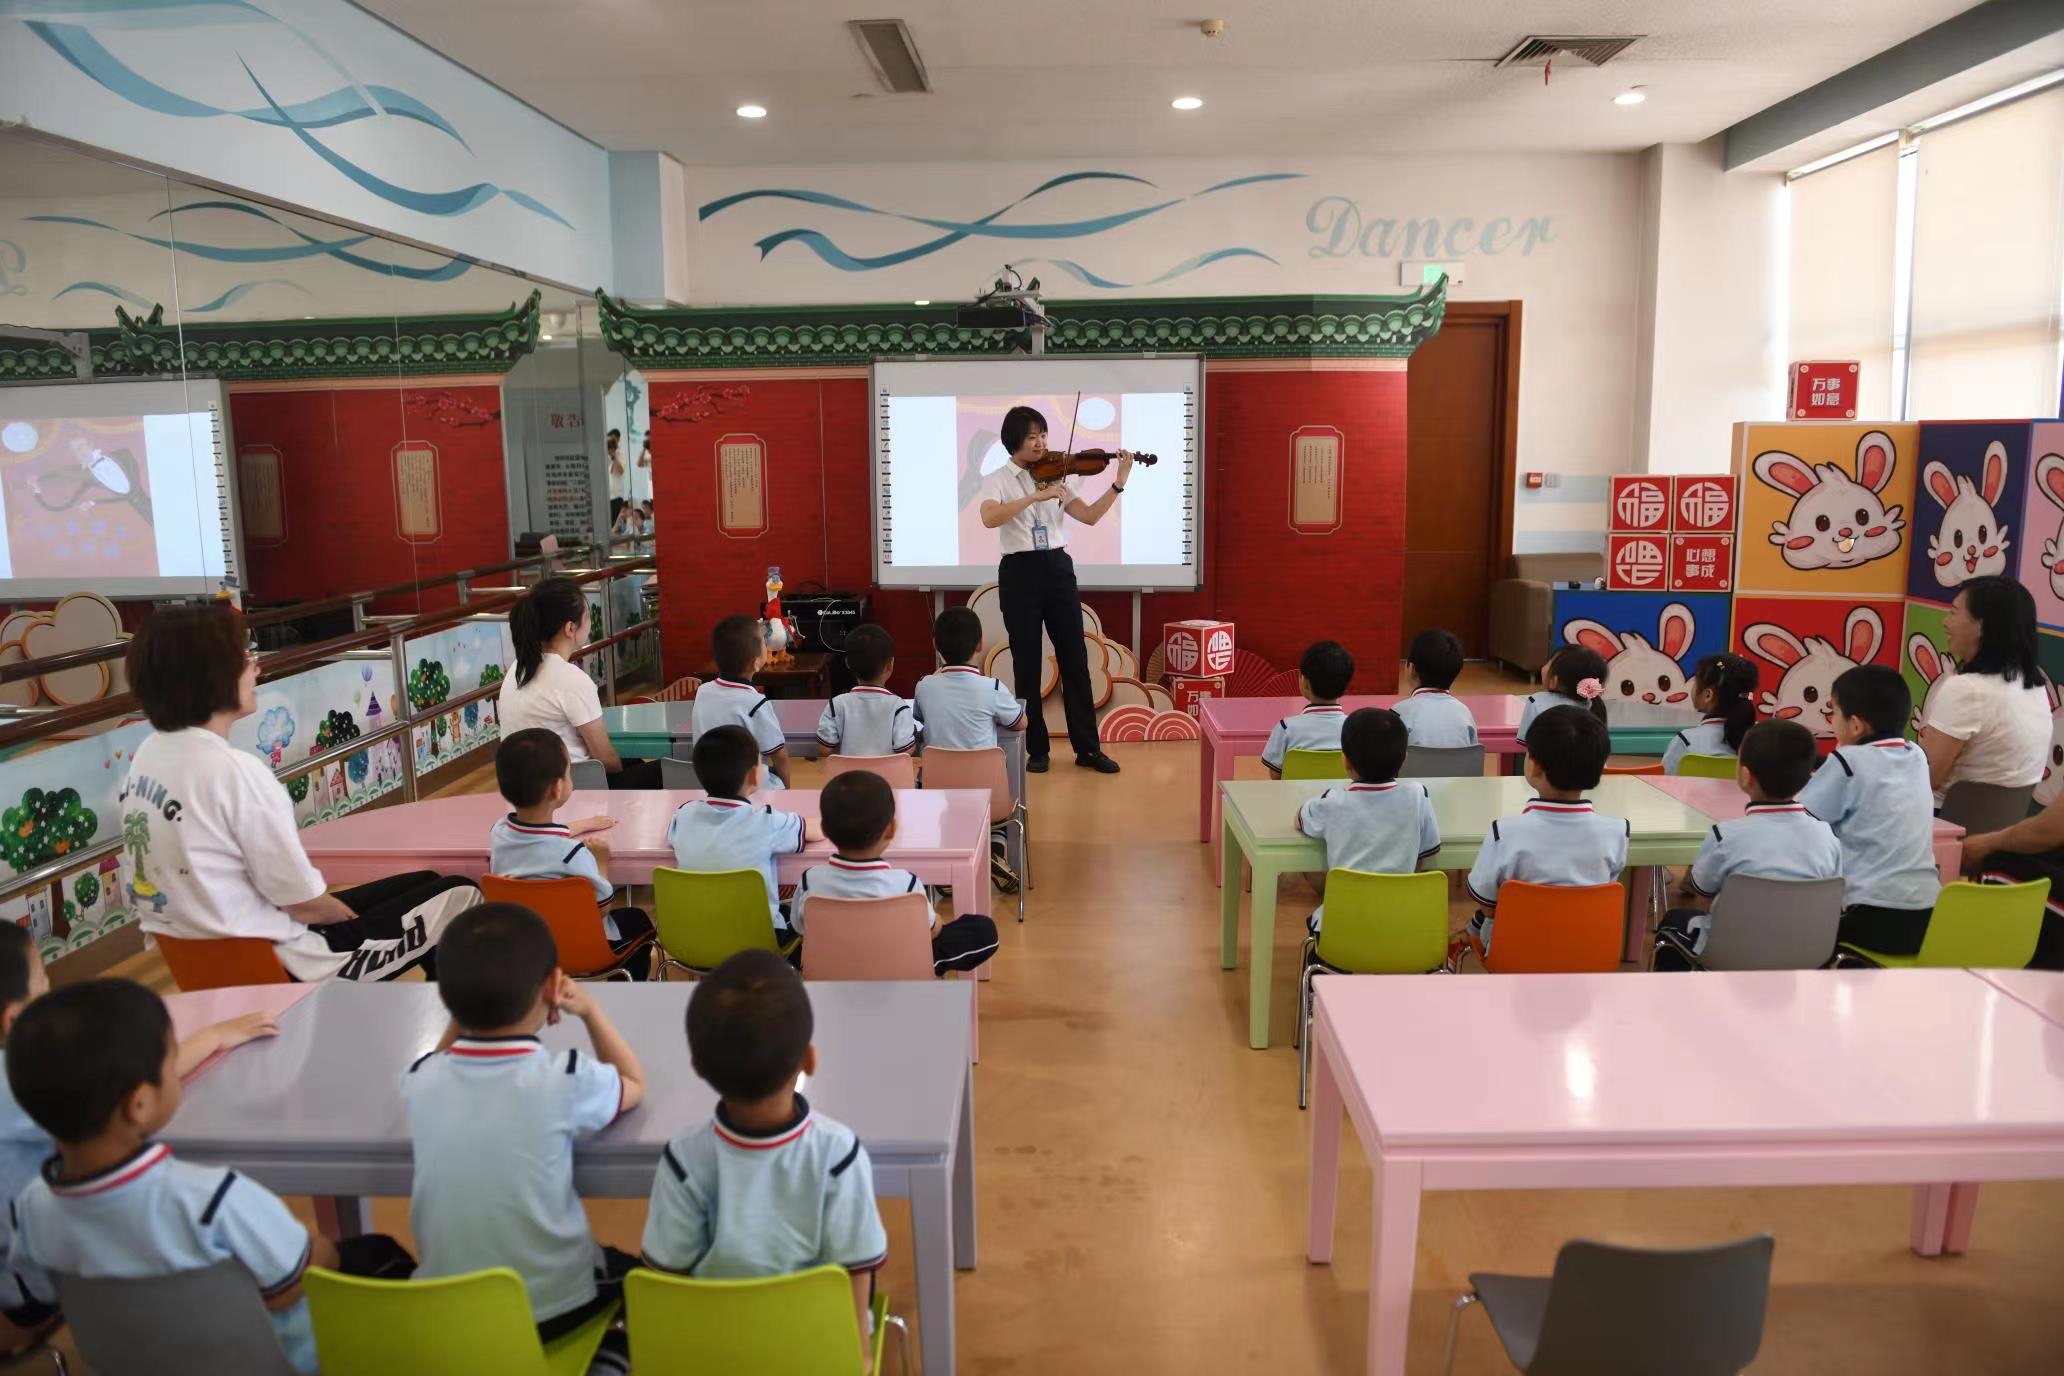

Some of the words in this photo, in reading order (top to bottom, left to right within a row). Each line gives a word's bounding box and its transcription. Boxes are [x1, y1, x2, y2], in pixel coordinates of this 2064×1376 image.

[1306, 196, 1557, 258] Dancer
[1812, 378, 1841, 391] 万事
[1812, 393, 1840, 406] 如意
[1617, 482, 1665, 528] 福
[1680, 482, 1730, 528] 福
[1685, 548, 1717, 562] 心想
[1685, 564, 1716, 578] 事成
[1166, 631, 1199, 672] 福
